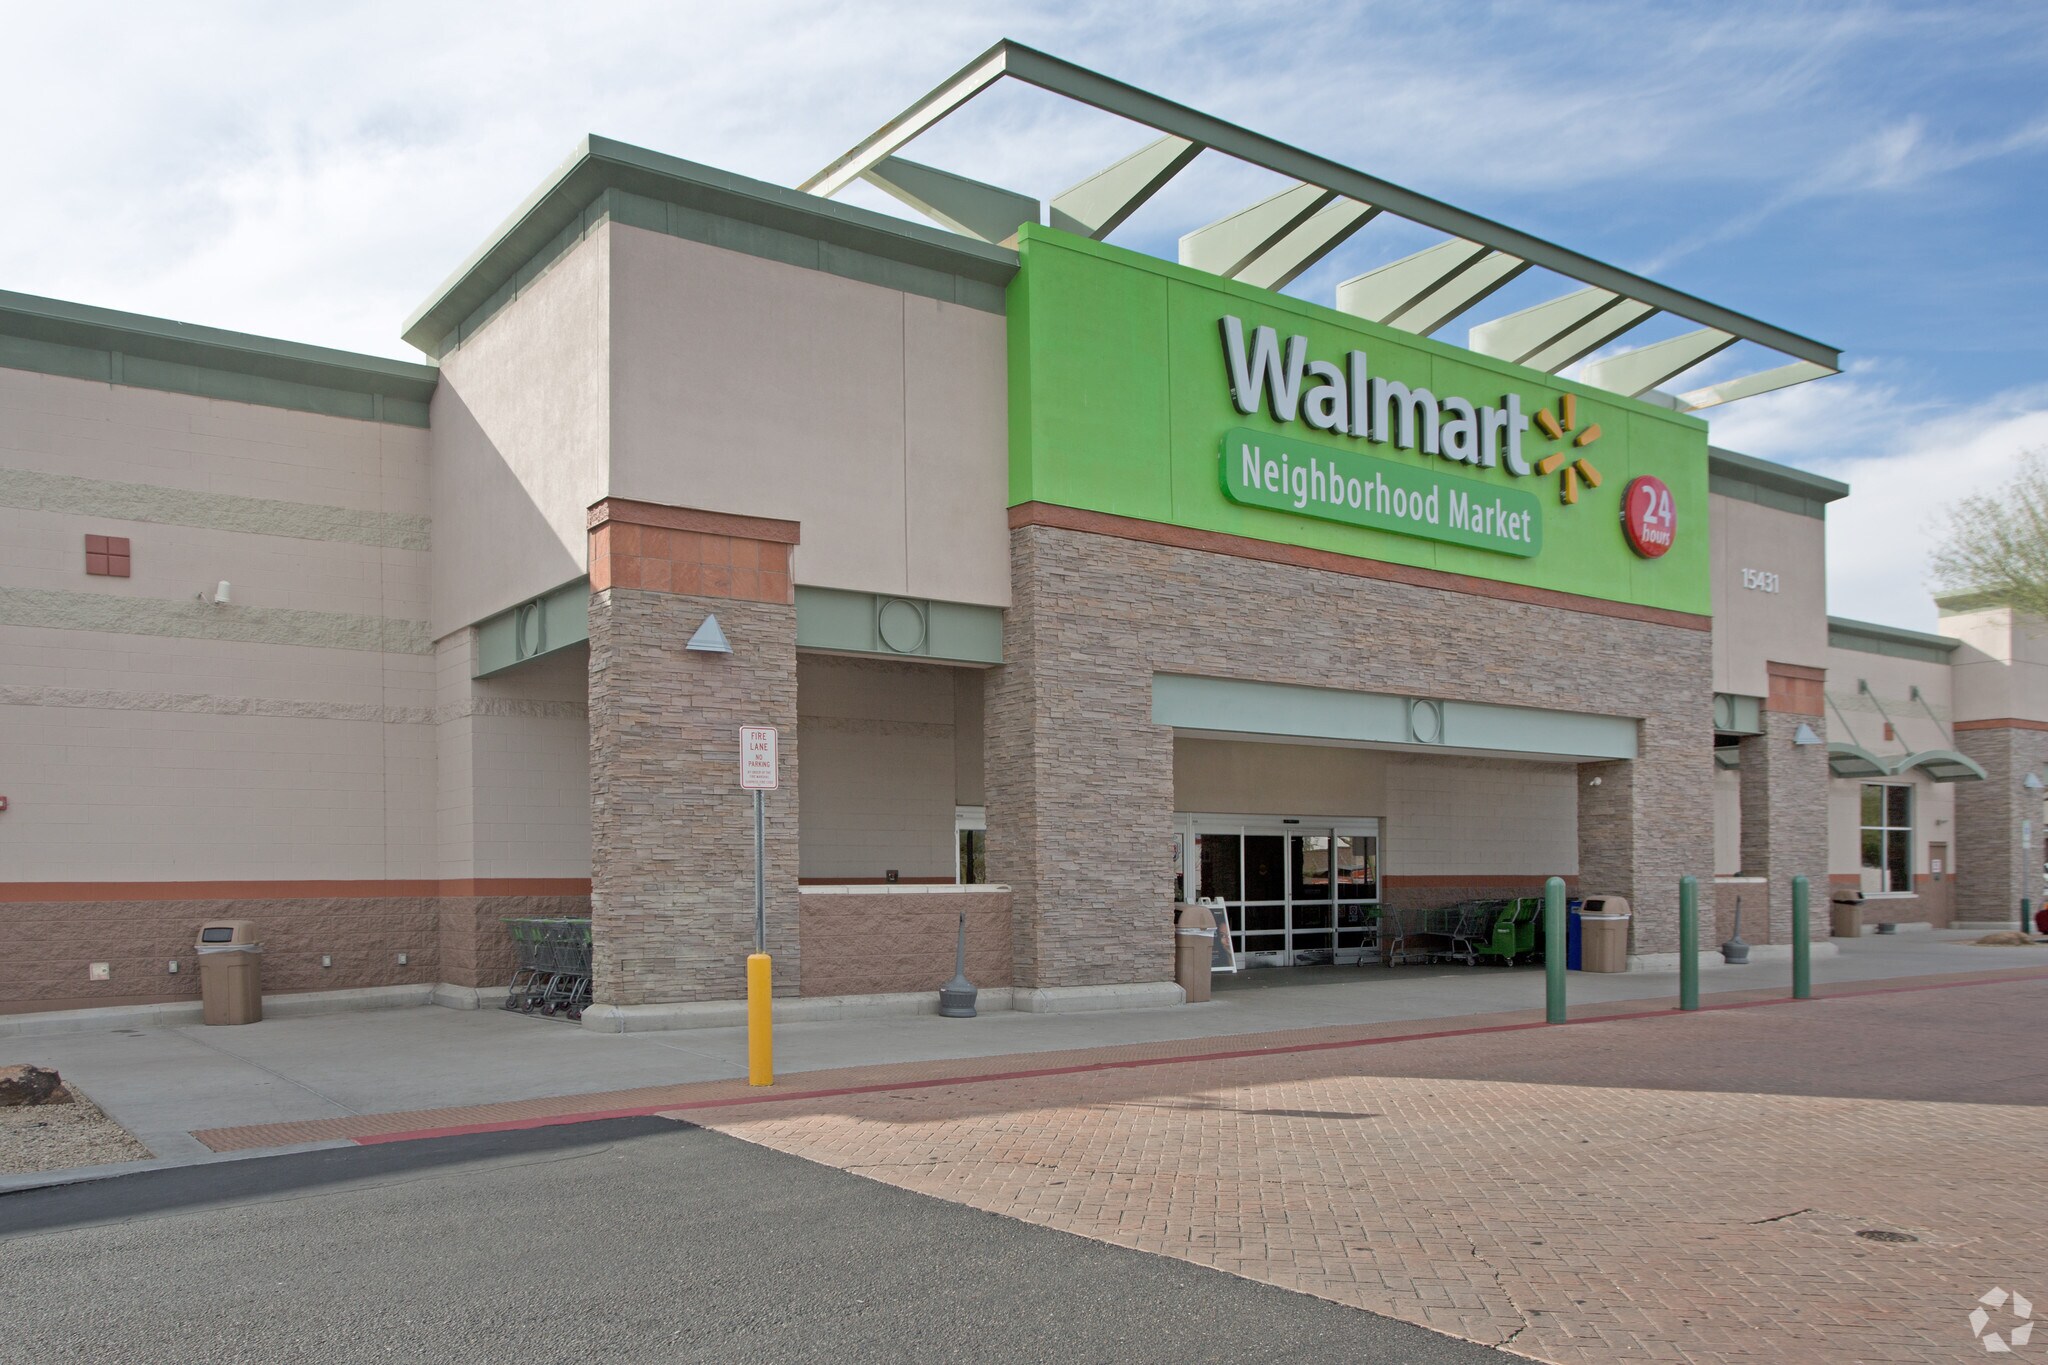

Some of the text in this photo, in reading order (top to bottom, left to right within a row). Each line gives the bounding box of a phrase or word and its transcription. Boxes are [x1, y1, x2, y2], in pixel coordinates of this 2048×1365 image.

[1218, 314, 1530, 477] Walmart
[1242, 444, 1532, 543] Neighborhood Market
[1642, 485, 1671, 527] 24
[1642, 523, 1670, 546] hours
[1741, 568, 1779, 594] 15431
[750, 743, 768, 751] LANE
[751, 732, 767, 741] FIRE
